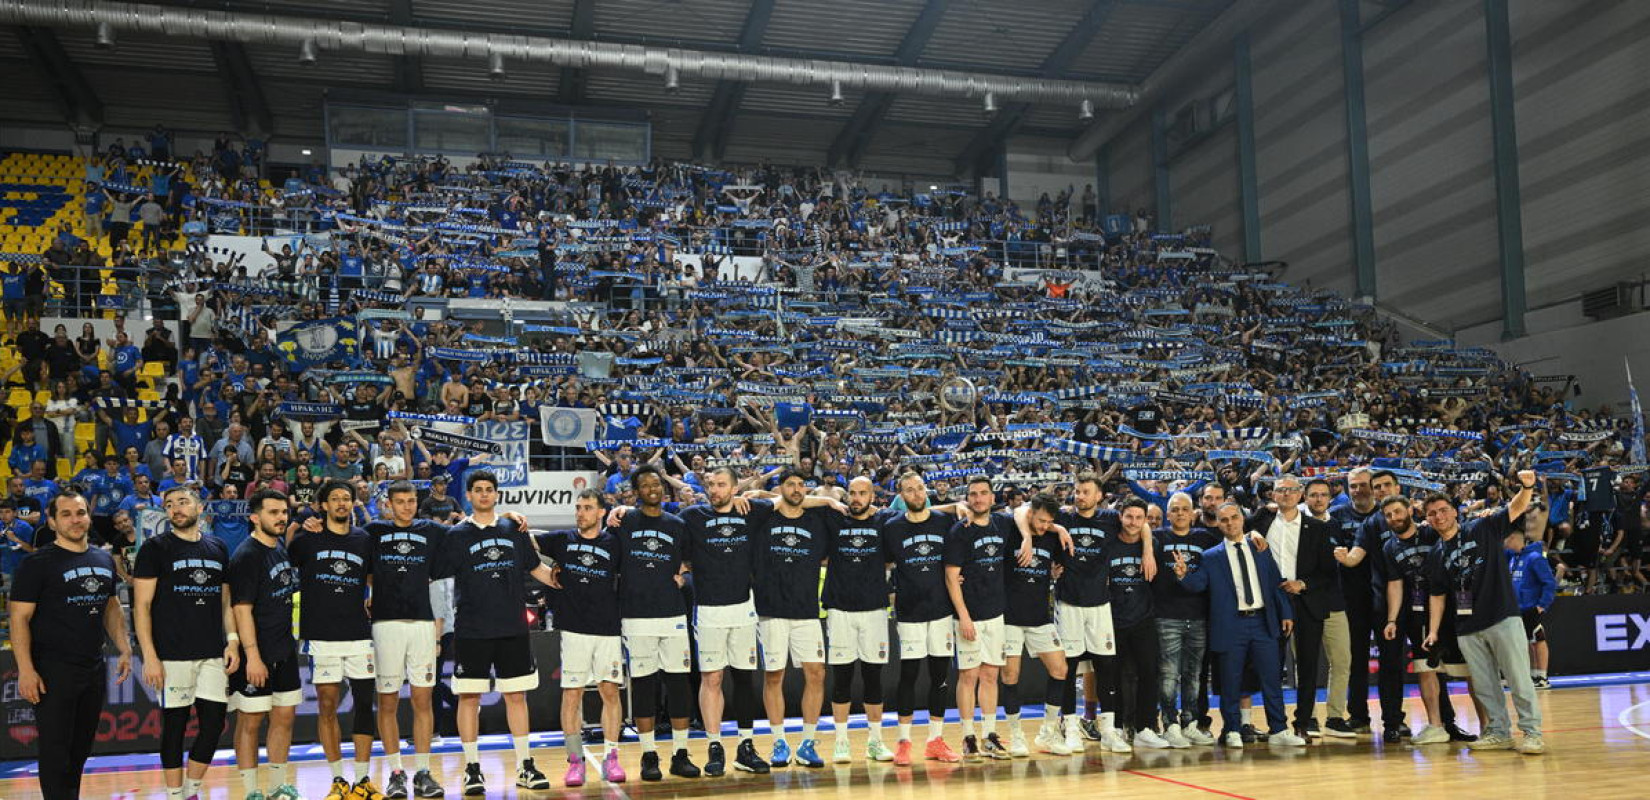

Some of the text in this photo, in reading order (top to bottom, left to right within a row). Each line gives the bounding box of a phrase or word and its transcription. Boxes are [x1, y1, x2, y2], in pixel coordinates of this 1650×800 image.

[290, 404, 333, 413] ΗΡΑΚΛΗΣ
[449, 436, 472, 446] VOLLEY
[473, 441, 489, 449] CLUB
[1590, 478, 1598, 491] 7
